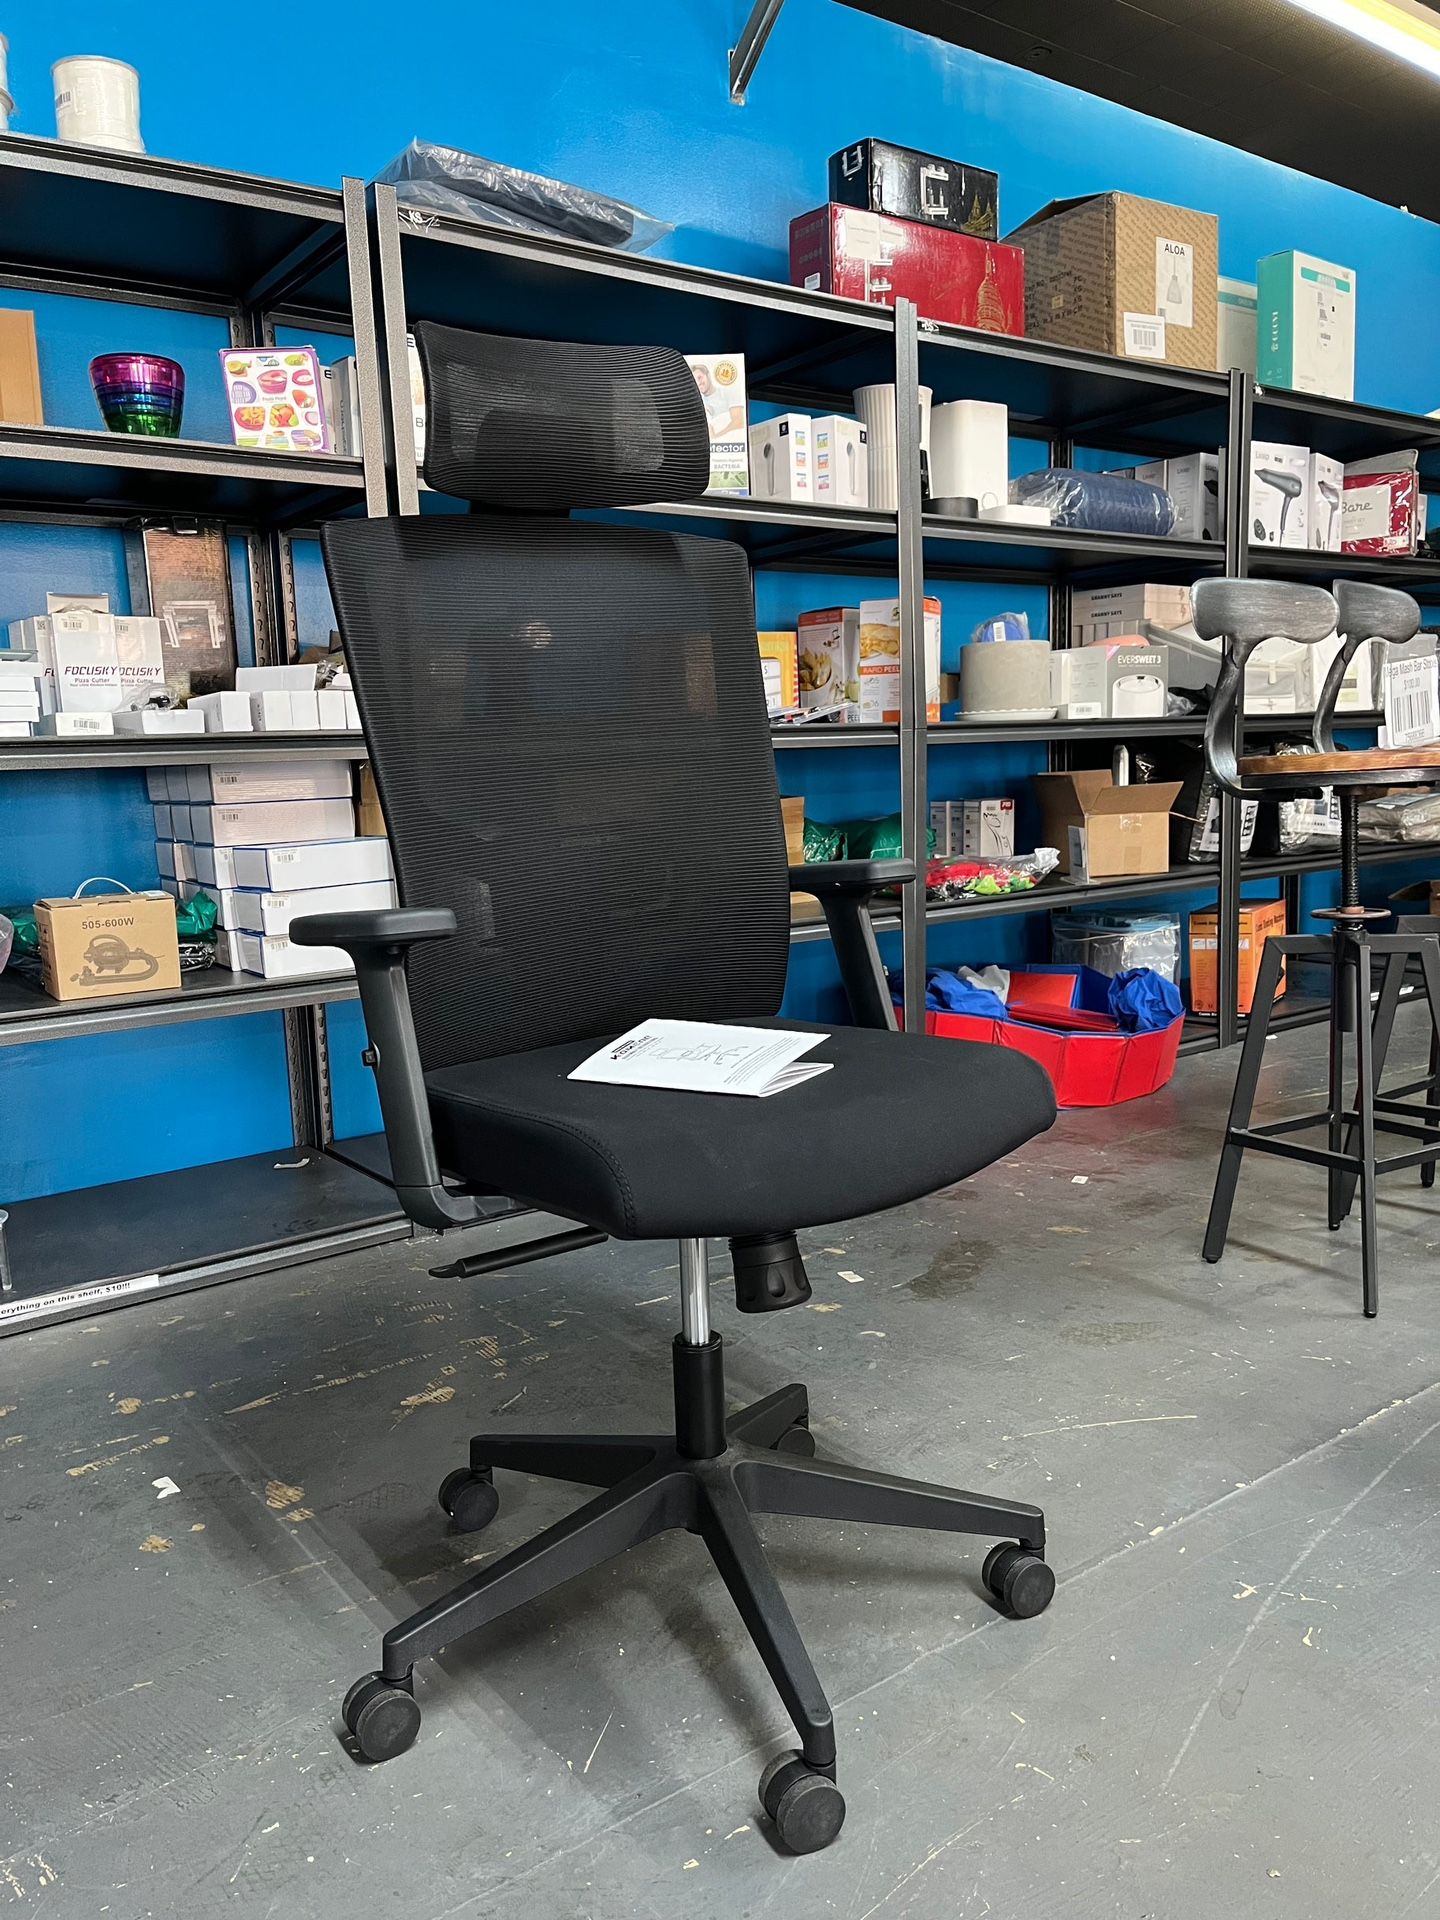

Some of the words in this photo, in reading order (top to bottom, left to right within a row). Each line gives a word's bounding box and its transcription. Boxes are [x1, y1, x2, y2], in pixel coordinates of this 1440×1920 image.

[1165, 243, 1185, 256] ALOA
[709, 444, 744, 452] tector
[65, 666, 117, 676] FOCUSKY
[119, 667, 161, 676] OCUSKY
[82, 917, 134, 930] 505-600W
[0, 1302, 41, 1315] erything
[58, 1295, 75, 1303] this
[78, 1288, 103, 1299] shelf,
